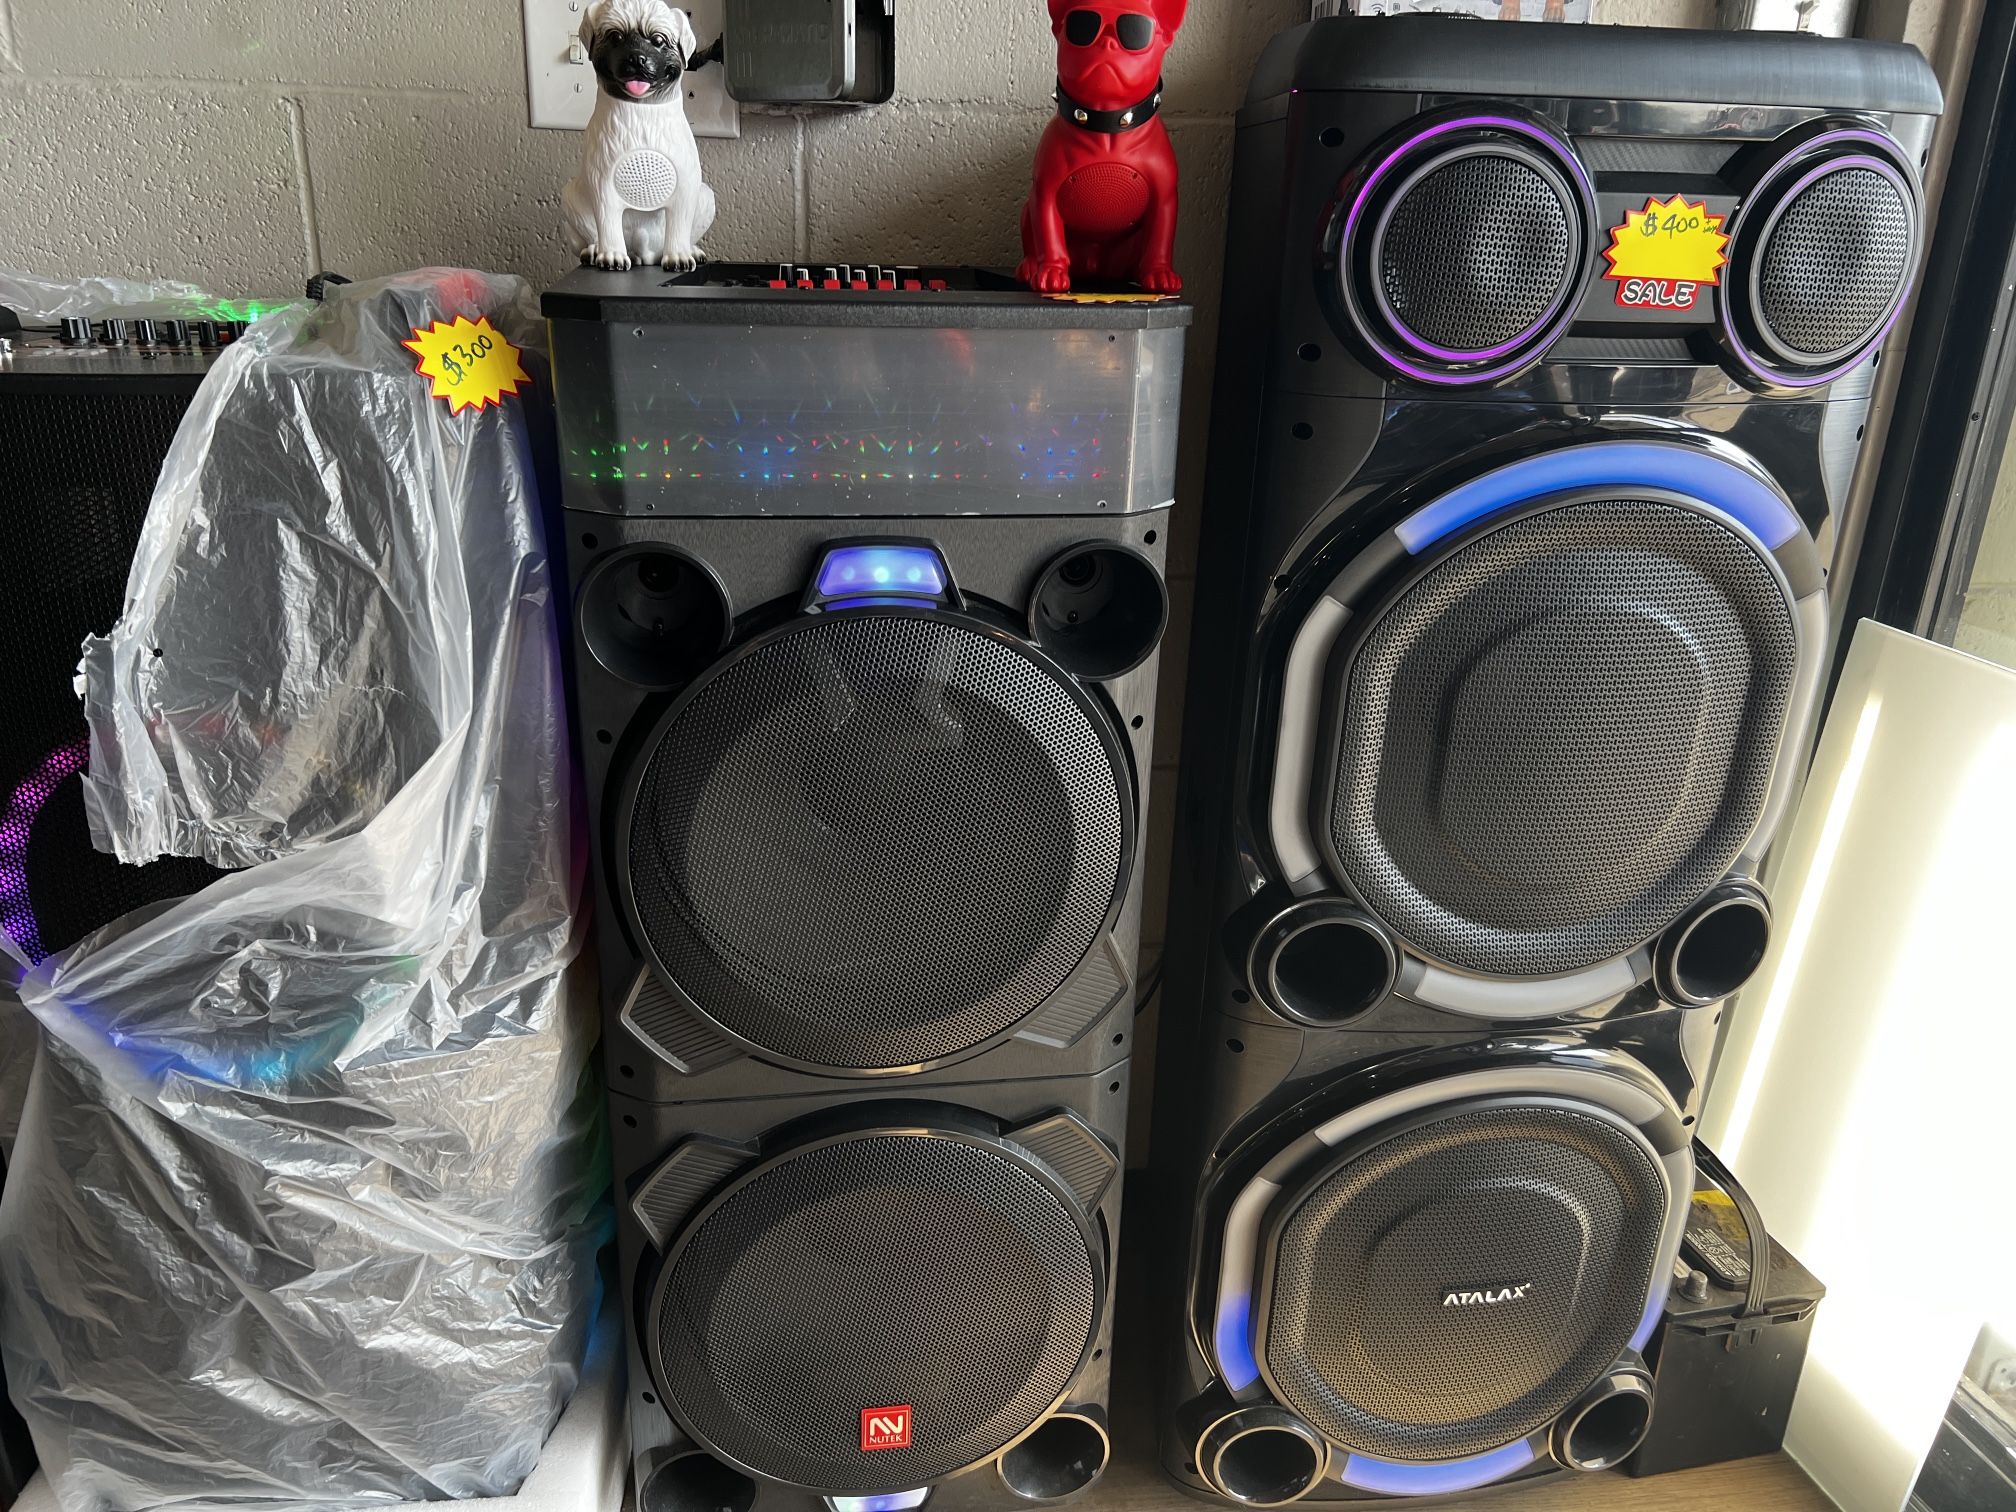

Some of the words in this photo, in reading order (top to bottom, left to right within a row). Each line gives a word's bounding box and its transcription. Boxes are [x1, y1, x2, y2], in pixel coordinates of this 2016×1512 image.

[1640, 212, 1699, 239] $400
[1621, 278, 1695, 307] SALE
[441, 335, 493, 386] $300
[1443, 1283, 1530, 1305] ATALAX
[869, 1434, 903, 1444] NUTEK
